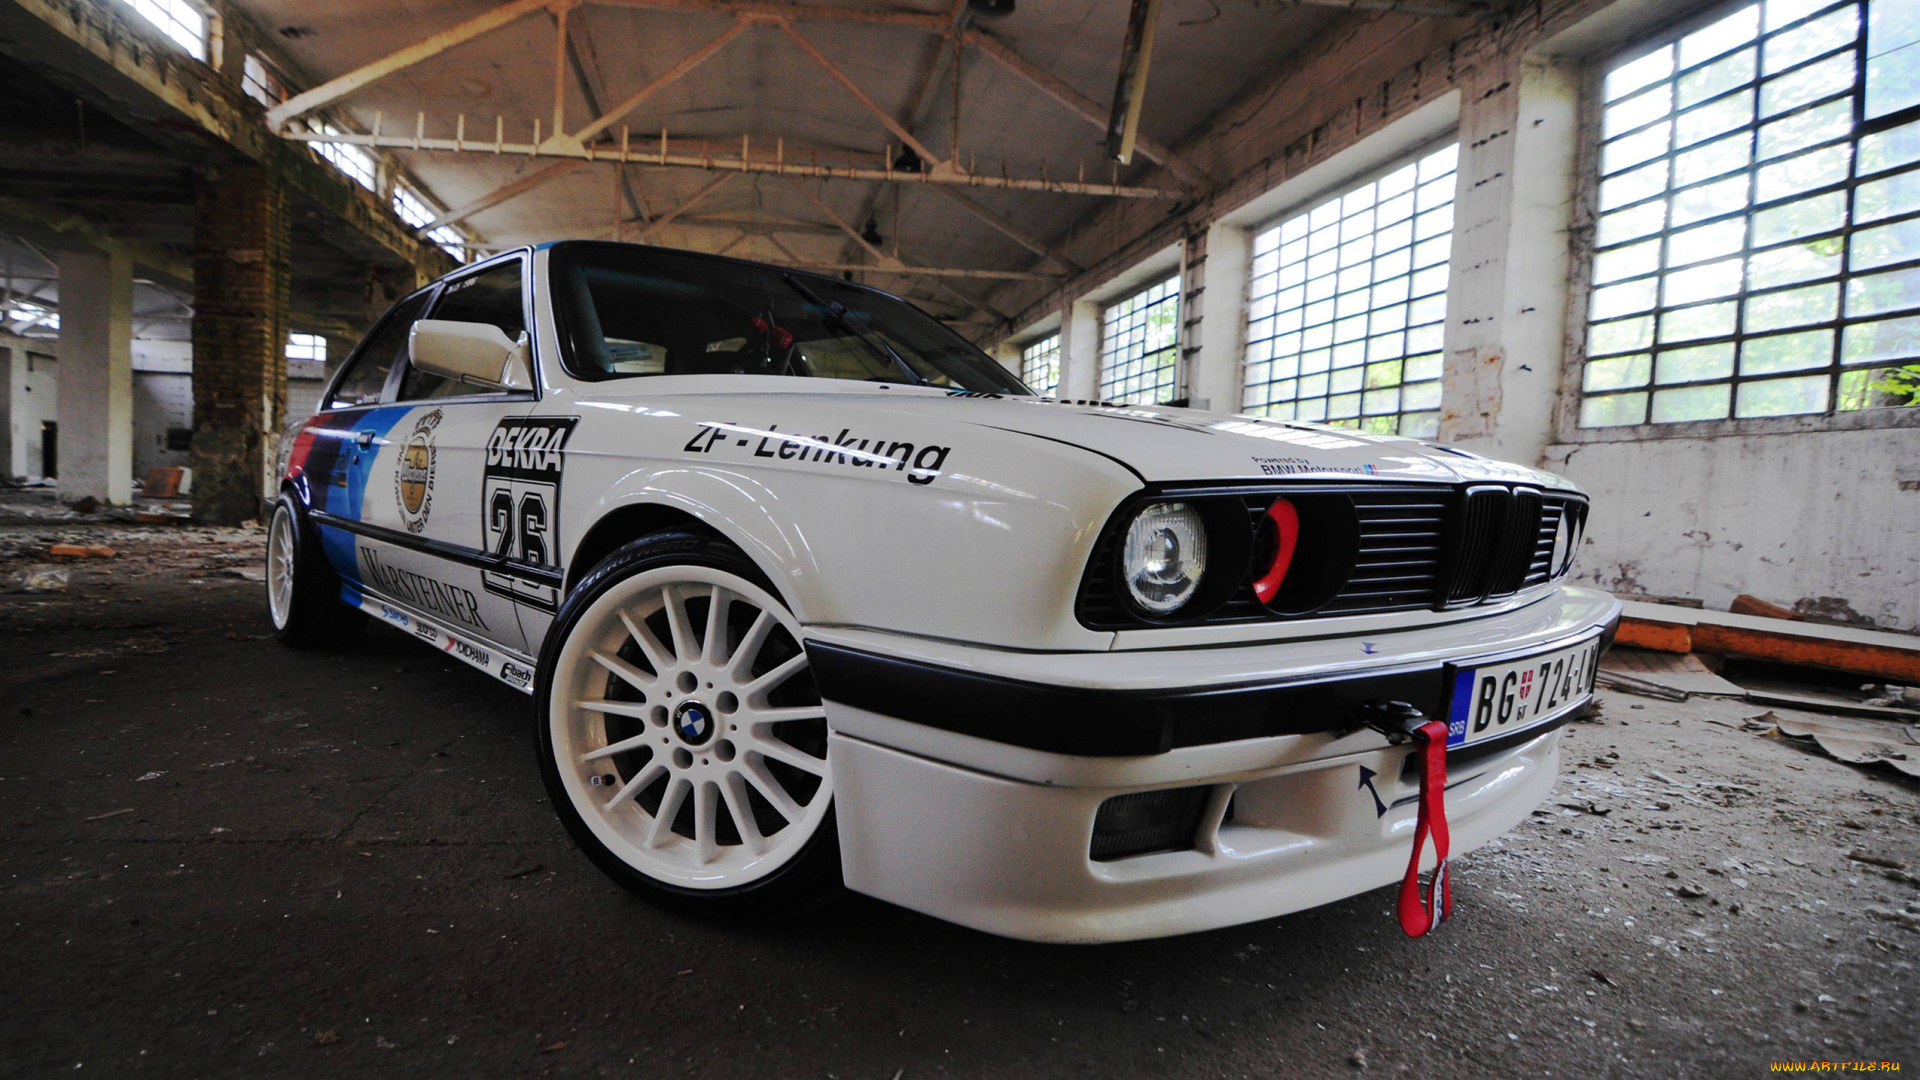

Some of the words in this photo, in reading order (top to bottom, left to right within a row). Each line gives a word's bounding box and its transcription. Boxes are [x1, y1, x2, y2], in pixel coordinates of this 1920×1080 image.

[487, 426, 566, 472] DEKRA
[754, 424, 951, 486] Lenkung
[1251, 456, 1294, 464] Powered
[1294, 457, 1310, 465] by
[1261, 464, 1296, 475] BMW
[1299, 465, 1363, 475] Motorsport
[490, 487, 547, 589] 26
[500, 662, 532, 681] Eibach
[1473, 670, 1517, 733] BG
[1448, 720, 1465, 737] SRB
